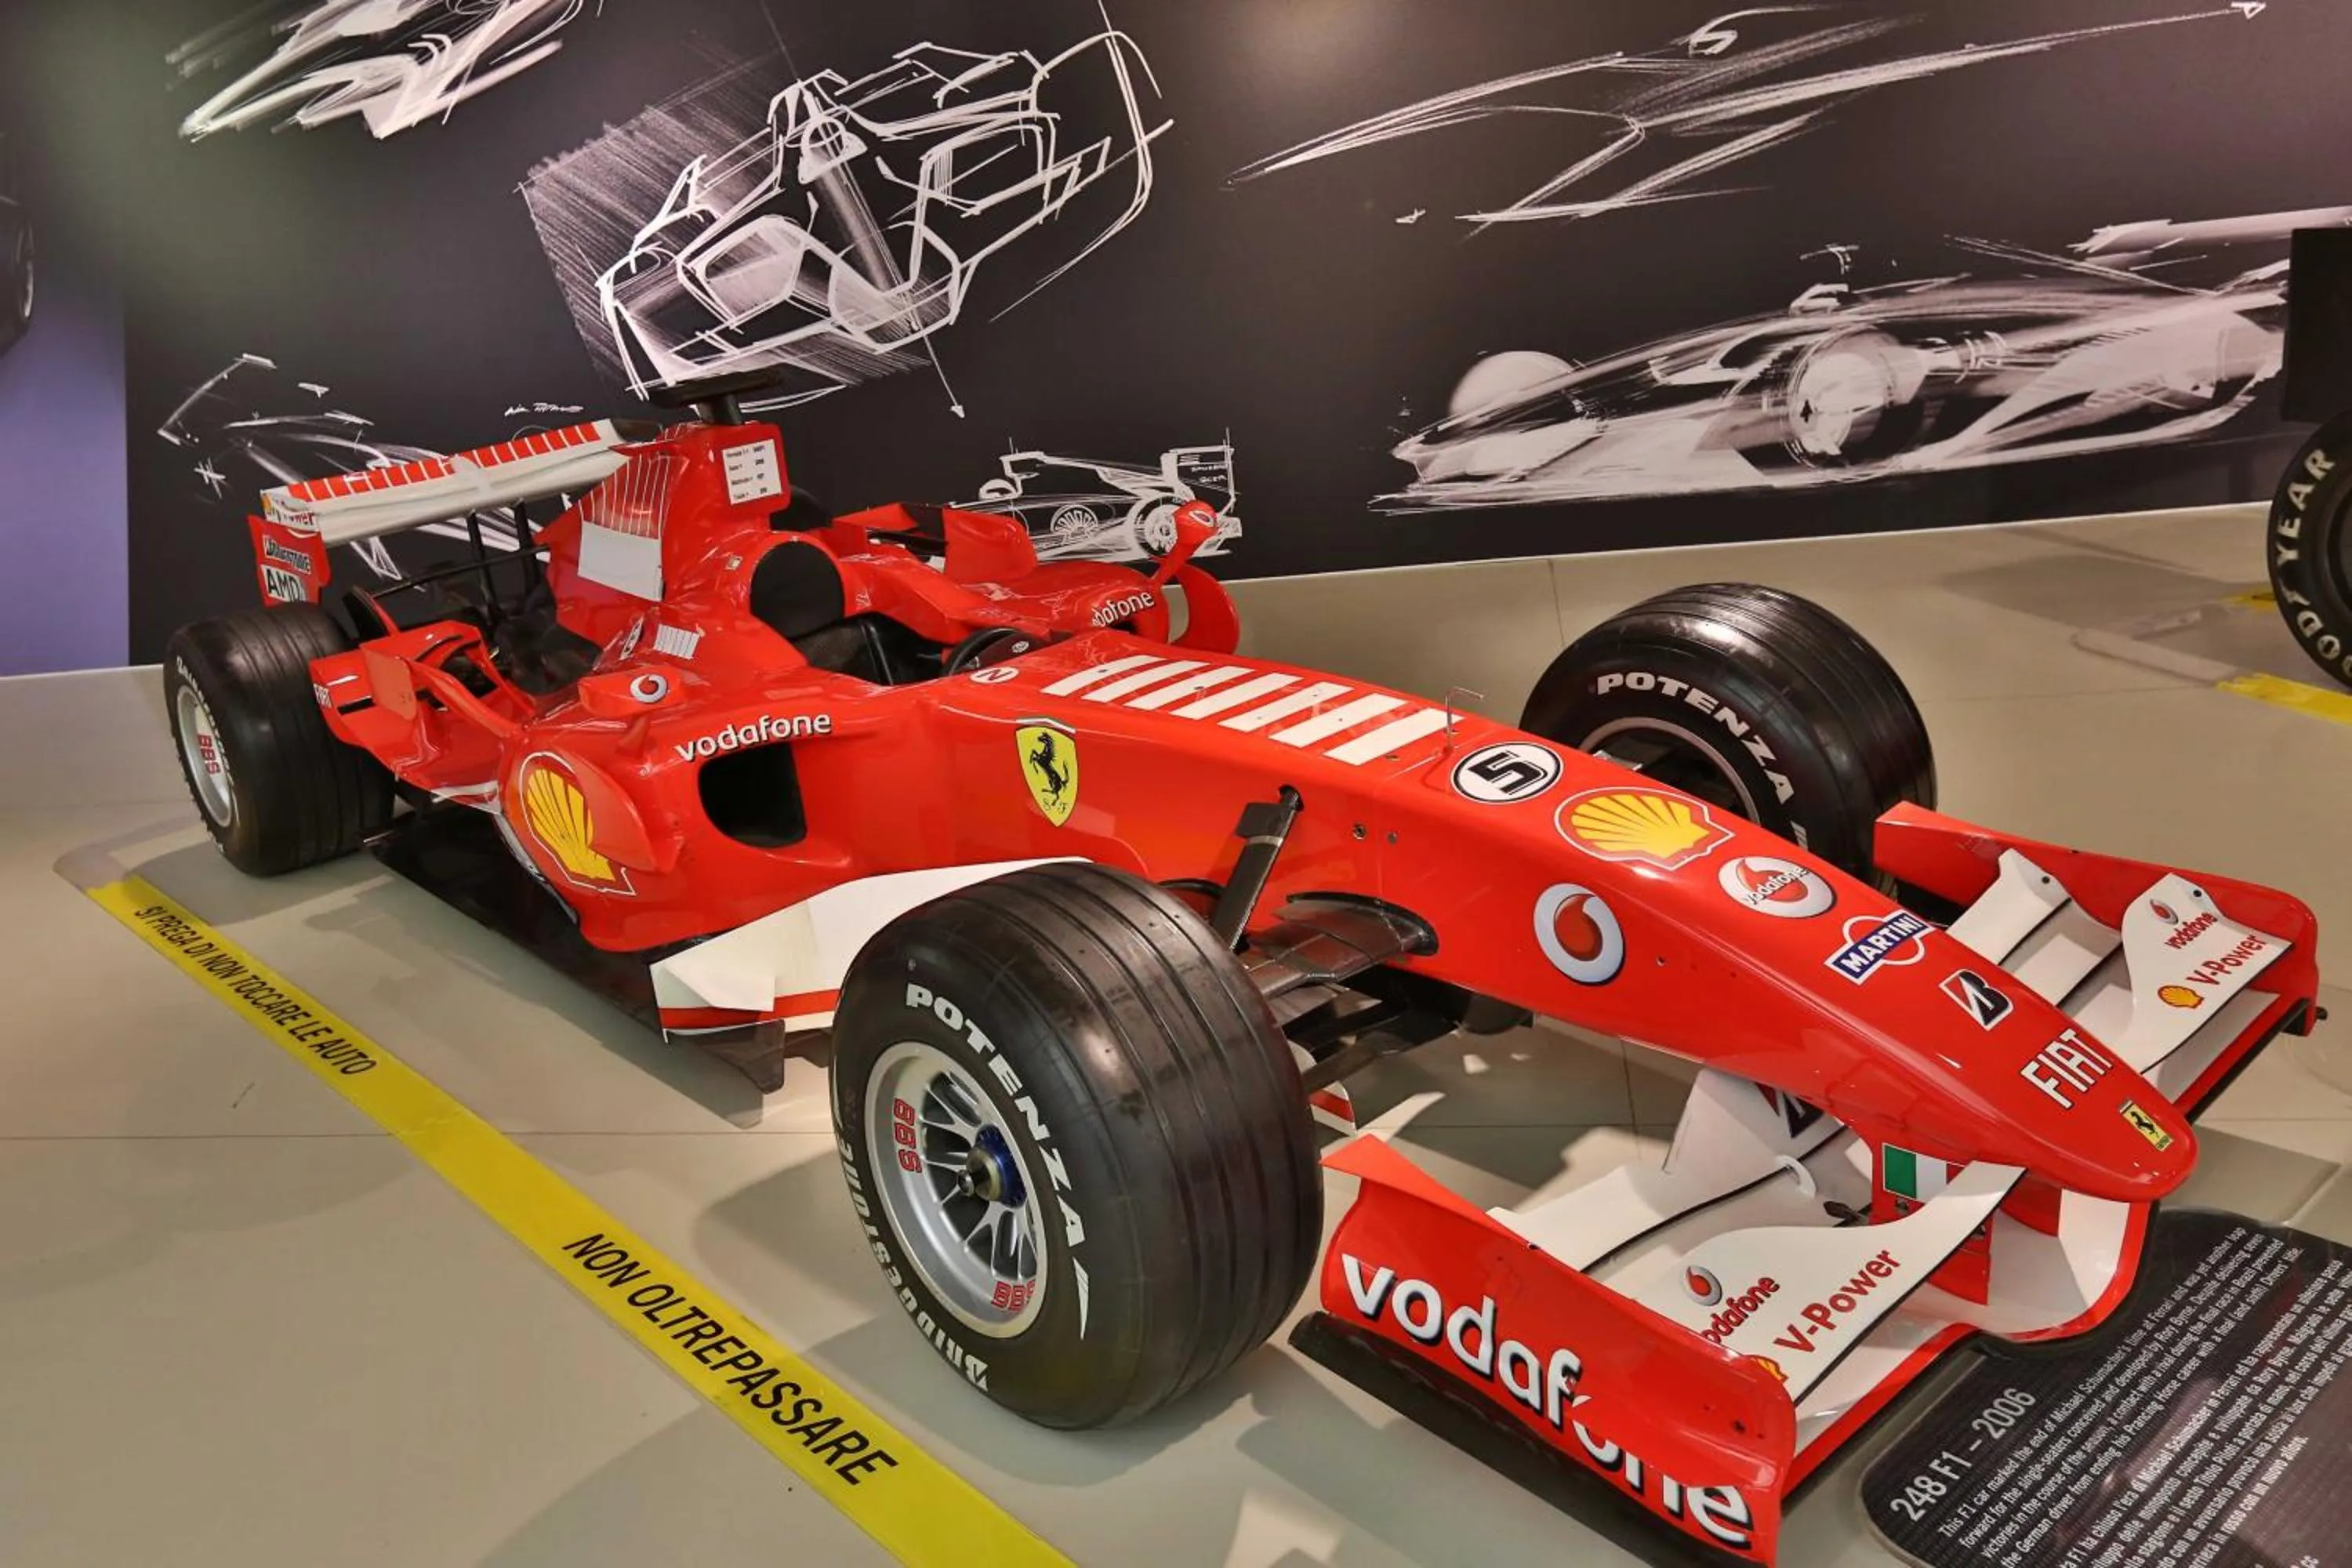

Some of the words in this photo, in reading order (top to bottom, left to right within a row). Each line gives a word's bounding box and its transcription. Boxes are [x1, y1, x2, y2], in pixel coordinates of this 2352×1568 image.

[266, 568, 301, 602] AMD
[675, 711, 833, 763] vodafone
[1596, 671, 1795, 805] POTENZA
[198, 734, 220, 775] BBS
[1468, 750, 1549, 798] 5
[1742, 865, 1809, 906] vodafone
[134, 906, 167, 920] SI
[150, 911, 204, 948] PREGA
[2164, 911, 2219, 950] vodafone
[183, 942, 220, 958] DI
[1840, 916, 1925, 974] MARTINI
[198, 953, 249, 980] NON
[2186, 934, 2267, 985] V-Power
[228, 975, 312, 1026] TOCCARE
[288, 1021, 332, 1043] LE
[307, 1038, 378, 1076] AUTO
[2020, 1027, 2114, 1110] FIAT
[905, 982, 1086, 1248] POTENZA
[892, 1098, 924, 1174] BBS
[2225, 1227, 2247, 1242] leap
[2205, 1240, 2232, 1263] another
[2250, 1238, 2285, 1270] prevented
[2183, 1273, 2201, 1287] was
[2194, 1261, 2212, 1276] yet
[2232, 1266, 2258, 1287] Brazil
[2322, 1260, 2344, 1280] passo
[1772, 1249, 1901, 1354] V-Power
[2170, 1284, 2189, 1299] and
[2215, 1293, 2234, 1309] race
[1700, 1276, 1780, 1345] odafone
[2147, 1298, 2176, 1321] Ferrari
[2198, 1305, 2221, 1323] final
[2141, 1319, 2155, 1329] at
[2188, 1320, 2208, 1334] the
[2287, 1312, 2324, 1345] Malgrado
[2169, 1332, 2199, 1356] during
[562, 1232, 651, 1288] NON
[626, 1283, 899, 1486] OLTREPASSARE
[2155, 1352, 2177, 1370] rival
[2234, 1363, 2251, 1375] ed
[2241, 1355, 2259, 1367] ha
[1958, 1514, 1996, 1545] forward
[1988, 1502, 2008, 1514] for
[2001, 1487, 2023, 1502] the
[2016, 1436, 2072, 1487] single-seaters
[2066, 1399, 2106, 1436] conceived
[2100, 1384, 2120, 1399] and
[2114, 1349, 2154, 1385] developed
[2144, 1341, 2163, 1352] by
[2154, 1325, 2179, 1342] Rory
[2169, 1304, 2198, 1326] Byrne.
[2189, 1279, 2221, 1305] Despite
[2213, 1249, 2251, 1280] delivering
[2242, 1232, 2265, 1251] seven
[2136, 1374, 2158, 1392] with
[2211, 1373, 2241, 1399] Ferrari
[2245, 1382, 2262, 1394] da
[2252, 1366, 2278, 1385] Rory
[2050, 1391, 2085, 1421] Michael
[2111, 1389, 2143, 1417] contact
[2204, 1397, 2221, 1408] in
[2213, 1394, 2253, 1432] sviluppate
[2028, 1429, 2049, 1446] end
[2043, 1420, 2057, 1431] of
[2164, 1406, 2213, 1452] Schumacher
[1889, 1475, 1947, 1518] 248
[1928, 1451, 1972, 1479] F1
[1971, 1387, 2036, 1437] 2006
[1999, 1552, 2022, 1568] the
[2015, 1518, 2053, 1552] German
[2047, 1494, 2074, 1518] driver
[2067, 1474, 2094, 1494] from
[2089, 1446, 2122, 1474] ending
[2111, 1433, 2132, 1447] his
[2124, 1400, 2164, 1434] Prancing
[2154, 1379, 2182, 1401] Horse
[2176, 1357, 2201, 1380] career
[2195, 1341, 2216, 1357] with
[2214, 1318, 2237, 1336] final
[2013, 1445, 2034, 1460] the
[2137, 1520, 2175, 1556] stagione
[2177, 1485, 2205, 1508] sesto
[2194, 1463, 2223, 1486] Titolo
[2212, 1442, 2240, 1465] Piloti
[2237, 1411, 2267, 1440] portata
[2258, 1403, 2274, 1414] di
[2295, 1352, 2318, 1373] corso
[2059, 1462, 2074, 1473] of
[2066, 1450, 2086, 1465] the
[2136, 1449, 2175, 1483] Michael
[2175, 1439, 2214, 1476] concepite
[1985, 1460, 2020, 1489] marked
[2036, 1473, 2066, 1500] course
[2129, 1479, 2148, 1491] di
[2169, 1540, 2190, 1558] con
[2183, 1528, 2201, 1541] un
[2192, 1486, 2234, 1529] avversario
[2252, 1441, 2273, 1457] una
[2285, 1398, 2307, 1414] box
[1957, 1503, 1976, 1517] F1
[1973, 1490, 1991, 1504] car
[2020, 1498, 2042, 1513] the
[2137, 1476, 2182, 1519] monoposto
[2209, 1531, 2229, 1544] in
[2220, 1510, 2247, 1534] rosso
[2240, 1494, 2261, 1511] con
[2261, 1459, 2288, 1484] nuovo
[1937, 1517, 1964, 1537] This
[2011, 1512, 2028, 1523] in
[2090, 1508, 2122, 1536] chiuso
[2117, 1519, 2144, 1541] delle
[1980, 1521, 2020, 1557] victories
[2077, 1535, 2099, 1549] ha
[2066, 1546, 2088, 1561] F1
